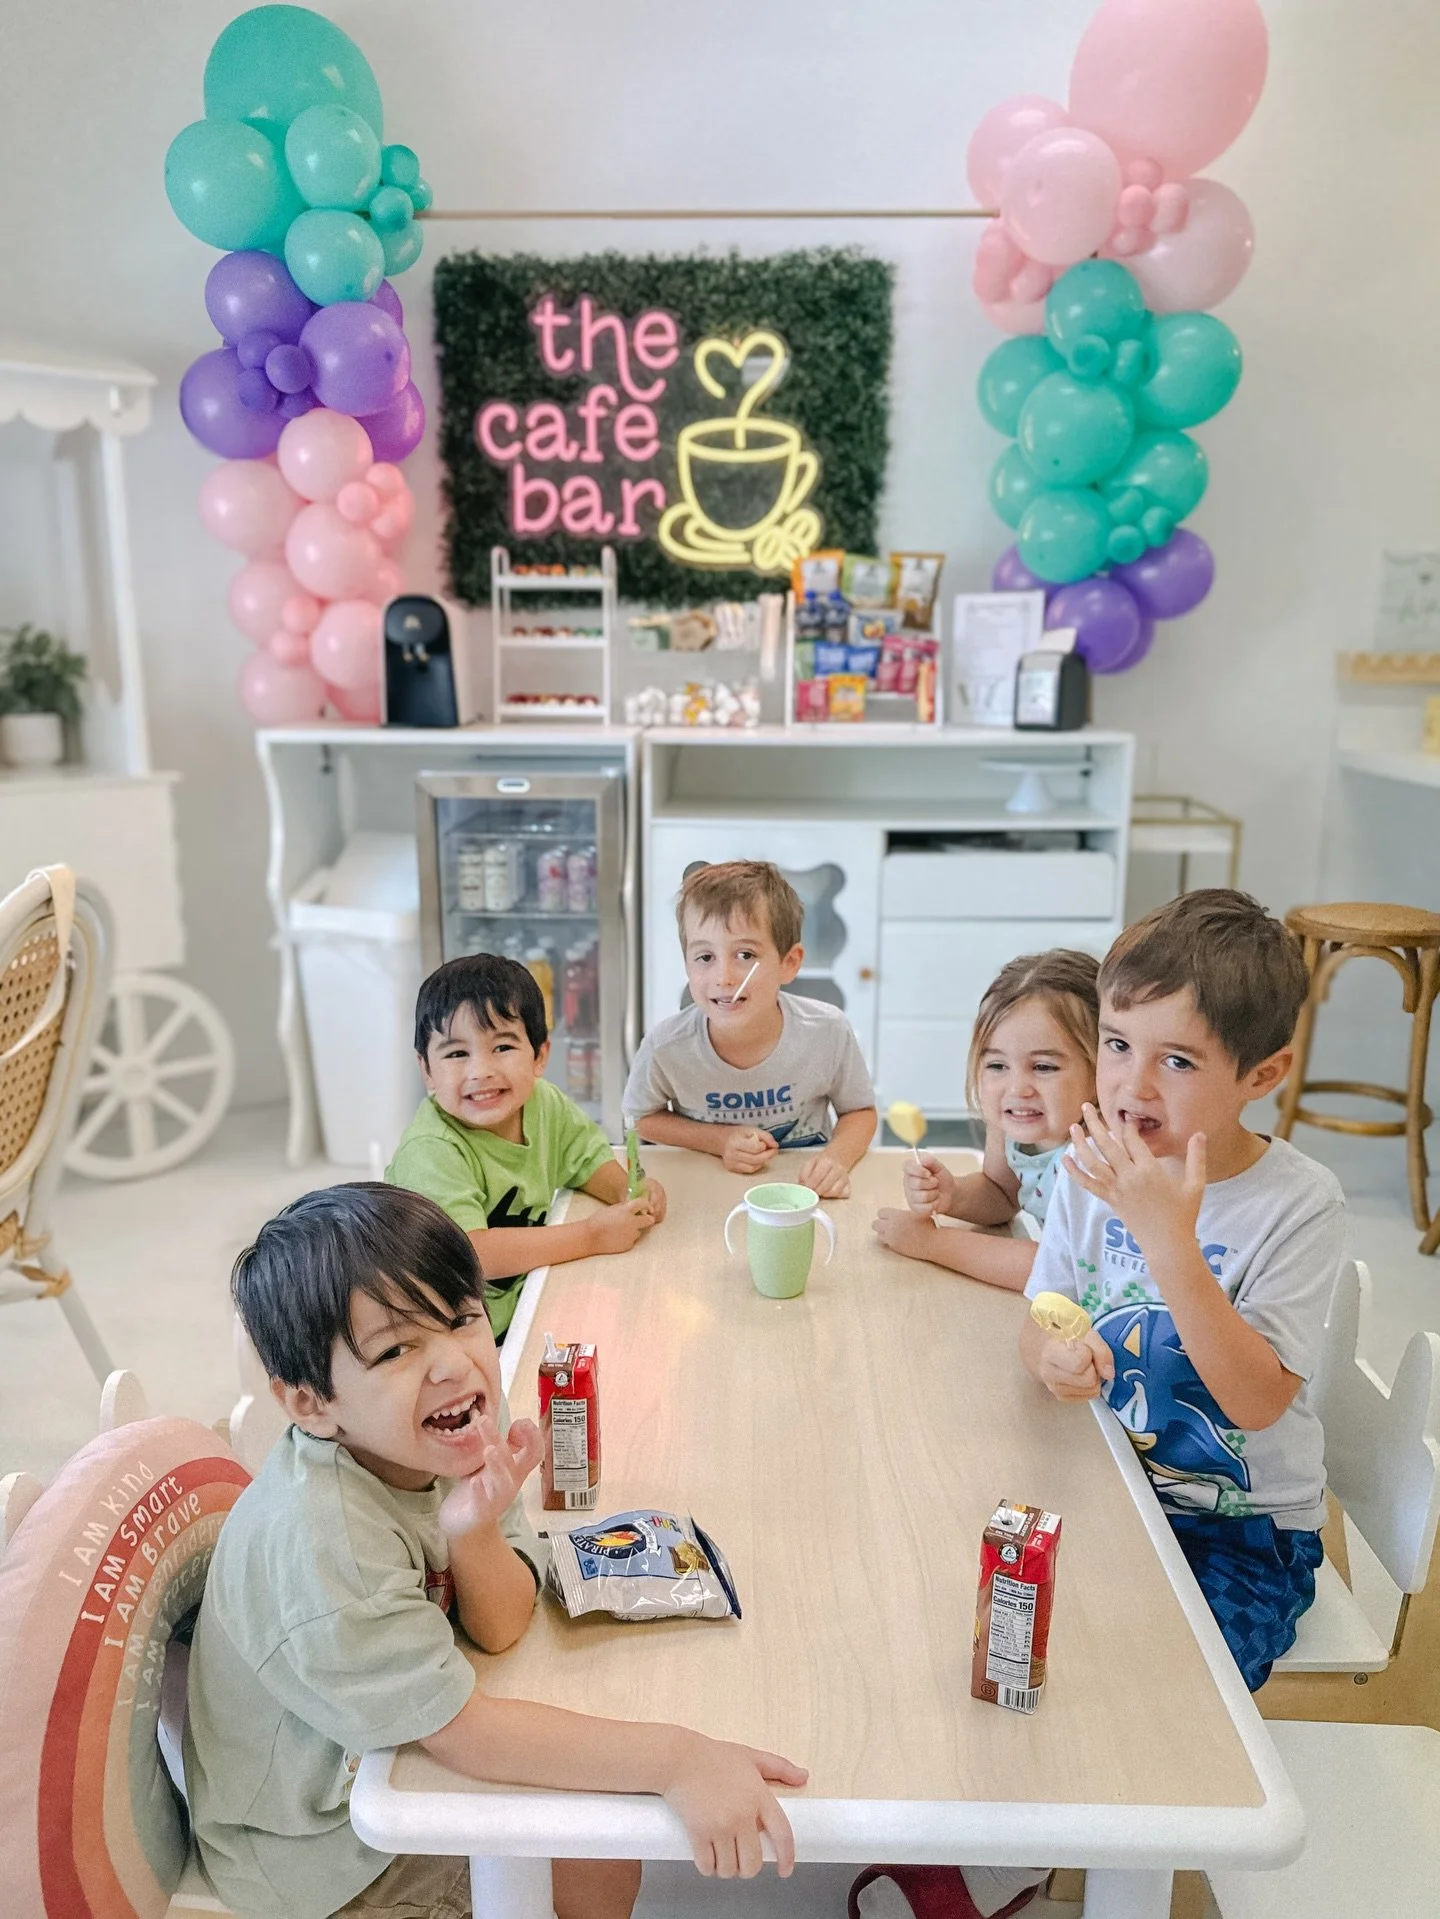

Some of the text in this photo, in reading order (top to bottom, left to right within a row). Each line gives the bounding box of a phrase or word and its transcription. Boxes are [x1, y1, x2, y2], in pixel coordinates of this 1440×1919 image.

[532, 293, 680, 403] the
[477, 384, 661, 463] cafe
[511, 463, 667, 536] bar
[705, 1084, 792, 1109] SONIC
[573, 1414, 586, 1423] 150
[58, 1570, 83, 1587] I
[72, 1521, 109, 1566] AM
[80, 1475, 183, 1625] I AM Smart
[103, 1492, 202, 1649] I AM Brave
[995, 1575, 1019, 1588] Nutrition
[993, 1595, 1034, 1611] Calories 150
